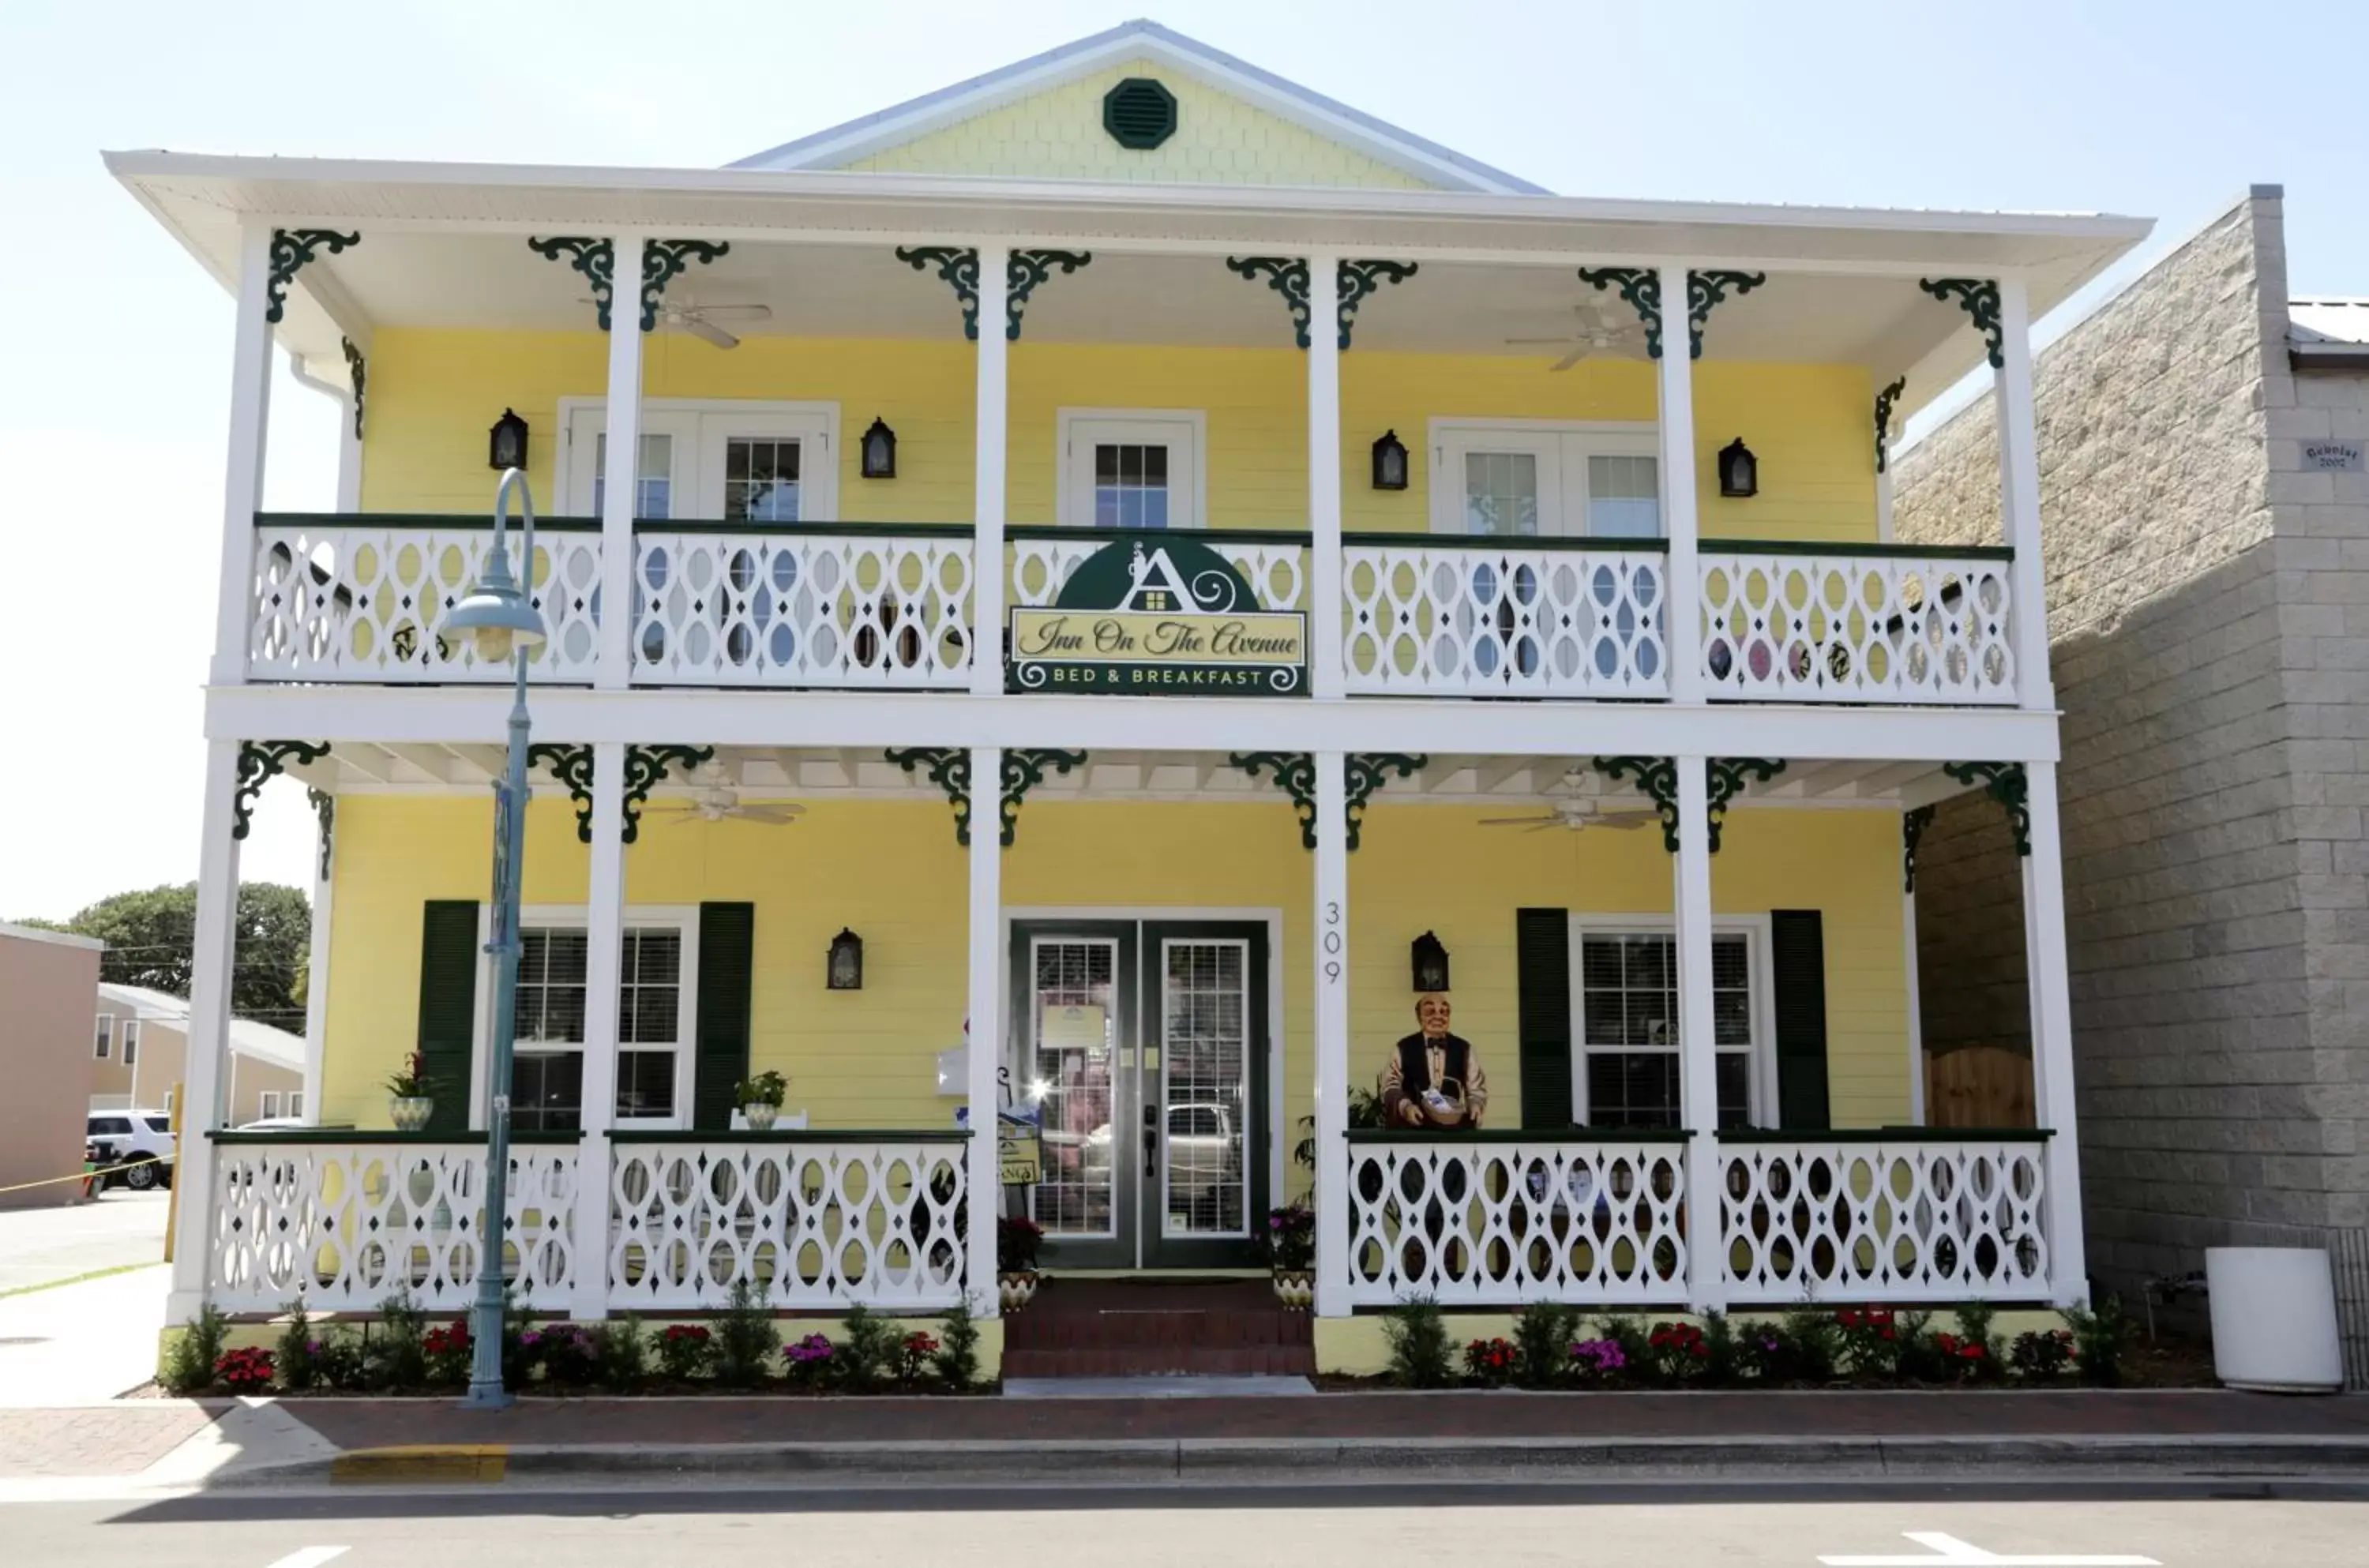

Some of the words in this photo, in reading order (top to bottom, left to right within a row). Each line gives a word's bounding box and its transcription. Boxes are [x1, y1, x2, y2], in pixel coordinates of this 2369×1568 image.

[1019, 615, 1084, 655] Inn
[1094, 618, 1136, 653] On
[1143, 621, 1203, 655] The
[1211, 620, 1297, 655] Avenue
[1054, 668, 1095, 682] BED
[1107, 669, 1120, 683] &
[1132, 669, 1262, 685] BREAKFAST
[1324, 901, 1341, 985] 309
